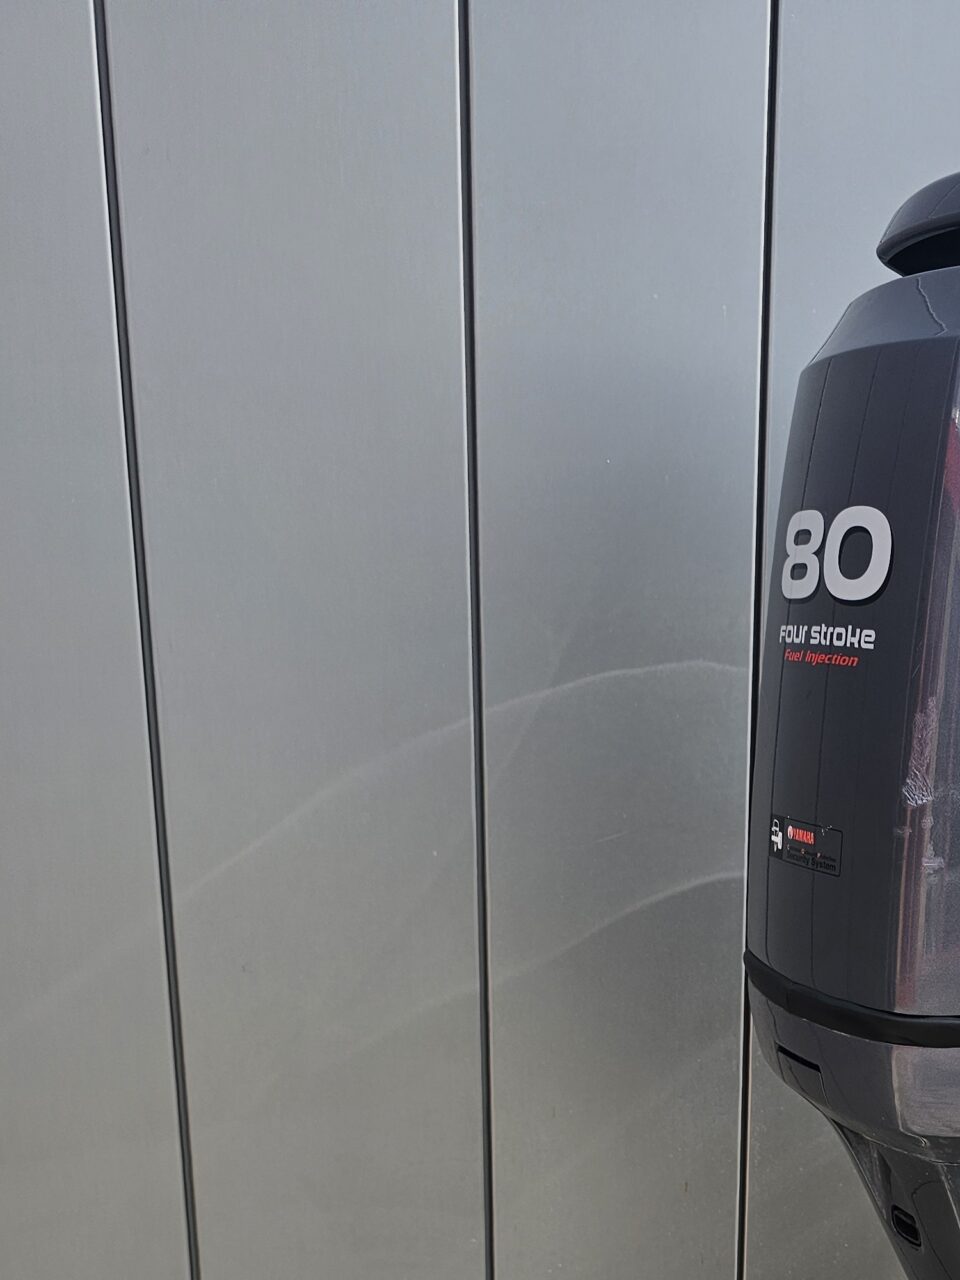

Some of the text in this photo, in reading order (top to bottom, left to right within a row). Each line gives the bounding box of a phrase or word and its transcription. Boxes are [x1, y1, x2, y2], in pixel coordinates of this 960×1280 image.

[781, 505, 893, 601] 80
[810, 623, 876, 650] stroke
[784, 648, 859, 667] Fuel Injection
[793, 828, 814, 844] YAMAHA
